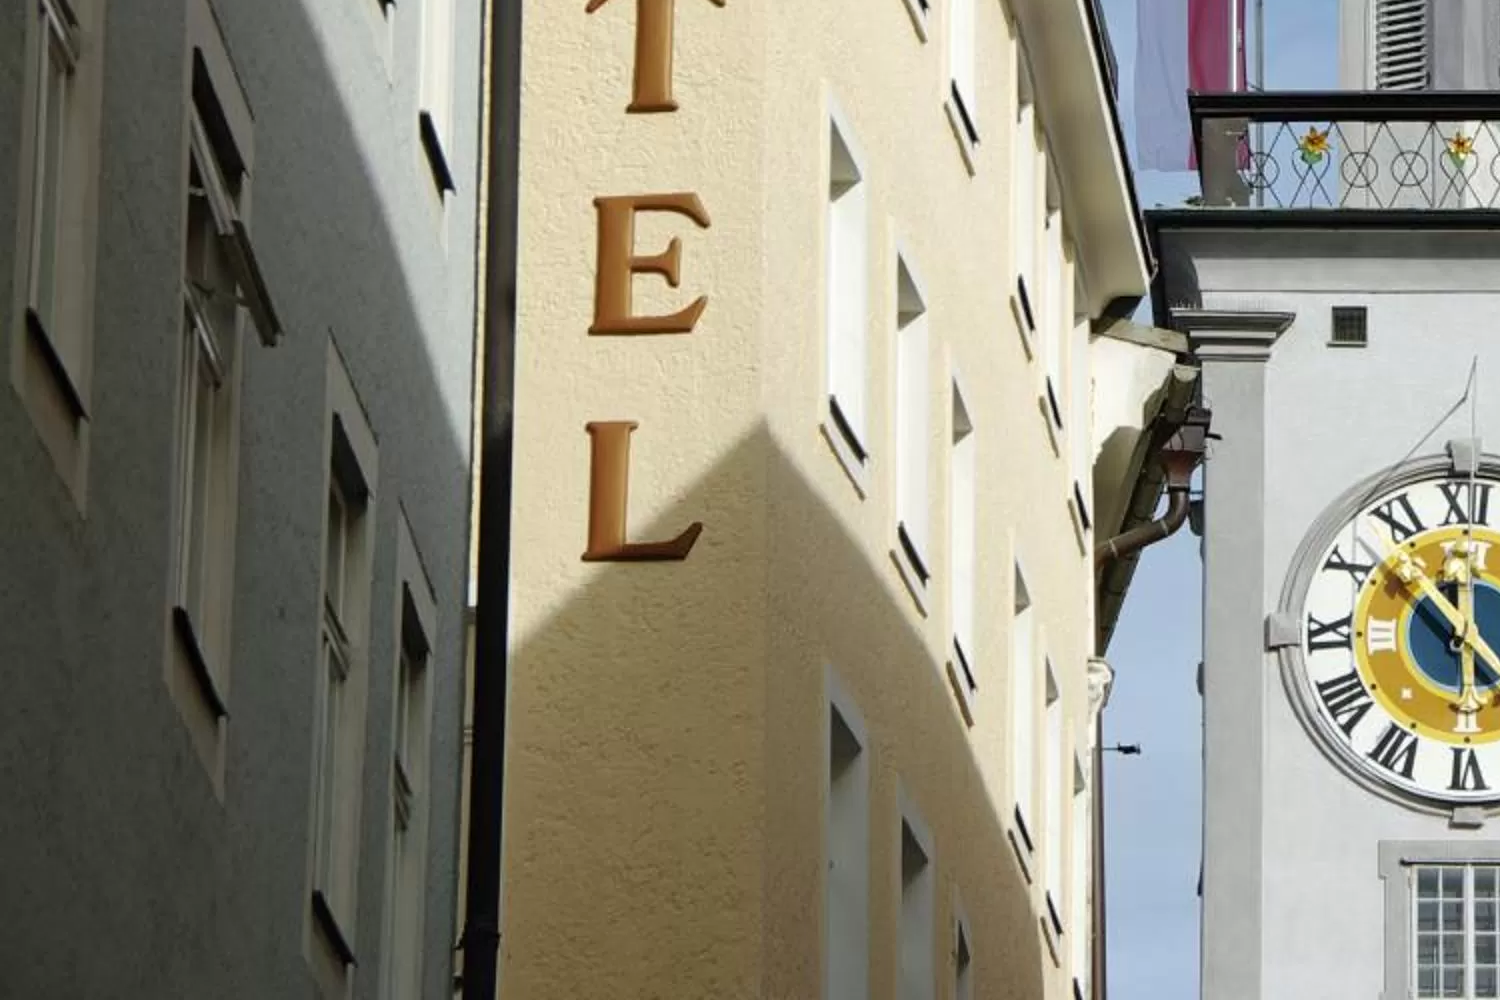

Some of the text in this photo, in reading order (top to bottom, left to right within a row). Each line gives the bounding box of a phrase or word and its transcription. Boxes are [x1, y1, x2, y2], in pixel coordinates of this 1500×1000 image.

[1367, 492, 1428, 545] XI
[1435, 482, 1494, 527] XII
[1322, 544, 1376, 592] X
[1308, 611, 1353, 655] IX
[1315, 667, 1375, 739] VIII
[1365, 720, 1418, 781] VII
[1445, 746, 1491, 790] VI
